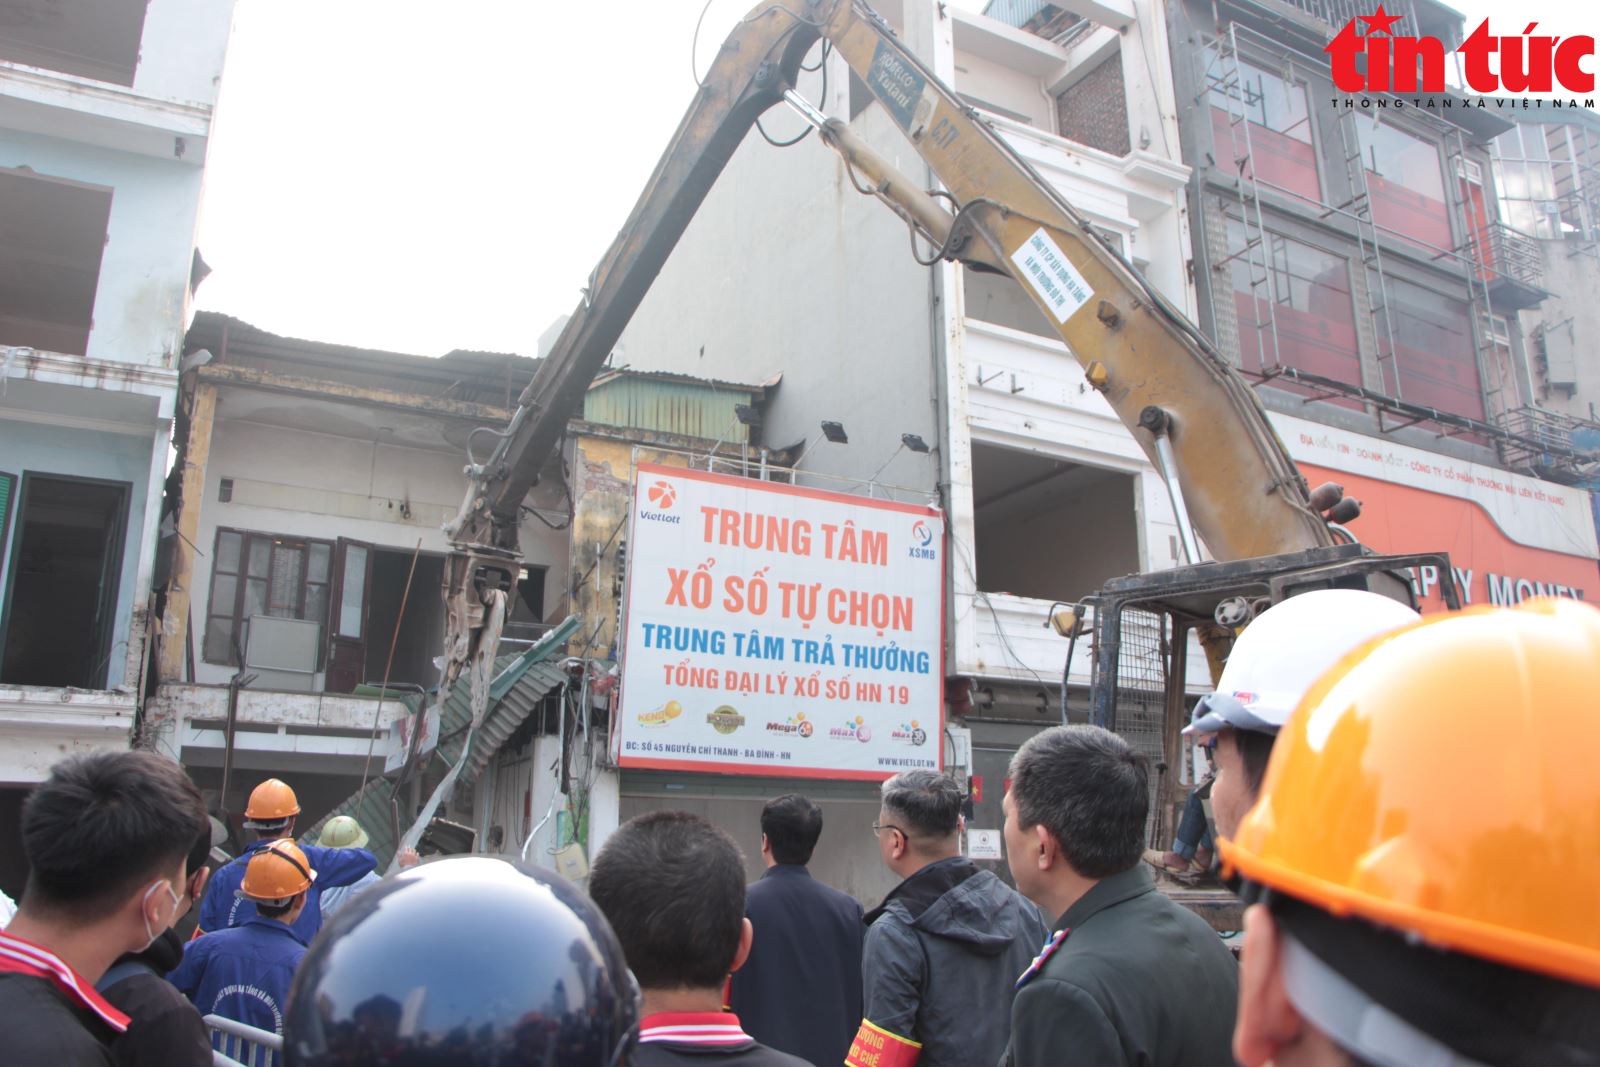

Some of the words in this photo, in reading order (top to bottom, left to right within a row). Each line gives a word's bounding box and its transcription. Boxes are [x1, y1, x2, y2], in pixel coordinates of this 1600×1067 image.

[640, 510, 681, 525] Vietlott
[700, 506, 811, 557] TRUNG
[821, 519, 888, 566] TÂM
[909, 547, 936, 560] XSMB
[665, 557, 716, 609] XỔ
[723, 566, 770, 616] SỐ
[778, 581, 822, 629] TỰ
[827, 587, 914, 637] CHỌN
[641, 622, 725, 656] TRUNG
[733, 629, 785, 661] TÂM
[792, 634, 835, 666] TRẢ
[842, 640, 930, 675] THƯỞNG
[664, 658, 719, 689] TỔNG
[724, 670, 758, 697] ĐẠI
[765, 670, 787, 696] LÝ
[793, 671, 821, 698] XỔ
[825, 674, 850, 701] SỐ
[856, 681, 884, 704] HN
[887, 685, 909, 705] 19
[766, 721, 797, 733] Mega
[641, 740, 651, 751] SỐ
[653, 743, 664, 752] 45
[713, 748, 738, 757] THANH
[744, 749, 755, 758] BA
[780, 752, 791, 760] HN
